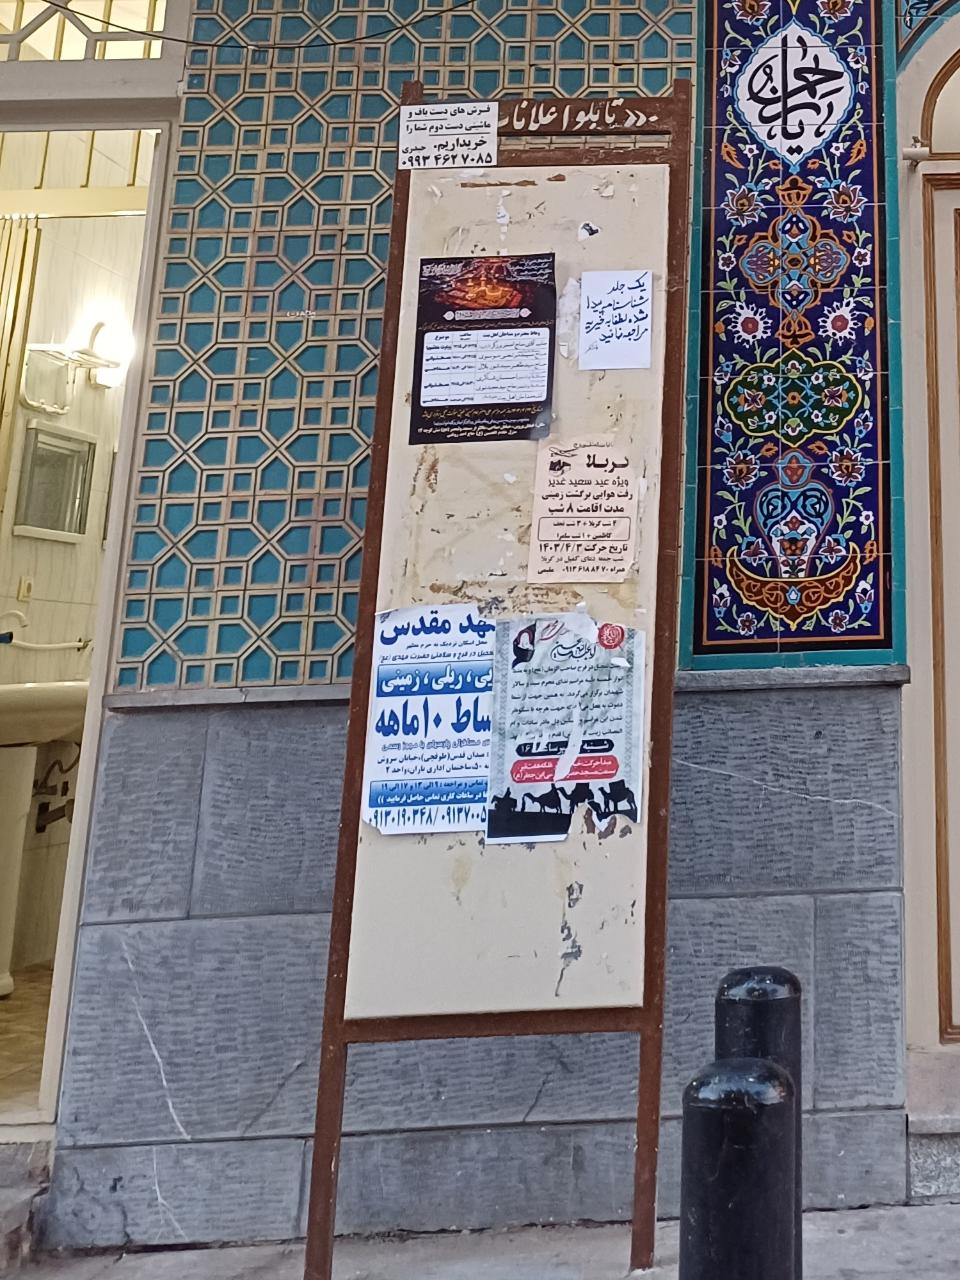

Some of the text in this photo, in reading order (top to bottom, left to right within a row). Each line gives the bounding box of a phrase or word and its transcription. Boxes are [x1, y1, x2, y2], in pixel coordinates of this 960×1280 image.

[407, 111, 413, 119] و
[449, 106, 465, 116] های
[466, 104, 490, 116] فرش
[405, 120, 491, 134] ماشینی دست دوم شما را
[607, 271, 648, 295] یک جلد
[629, 309, 649, 324] شده
[548, 476, 629, 487] ویژه عید سعید غدیر
[541, 489, 633, 501] رفت هوایی برگشت زمینی
[548, 503, 565, 515] شب
[576, 503, 602, 513] اقامت
[604, 504, 625, 513] مدت
[584, 544, 607, 554] حرکت
[608, 543, 628, 554] تاریخ
[380, 610, 452, 646] مقدس
[459, 613, 496, 638] هد
[381, 669, 420, 693] زمینی
